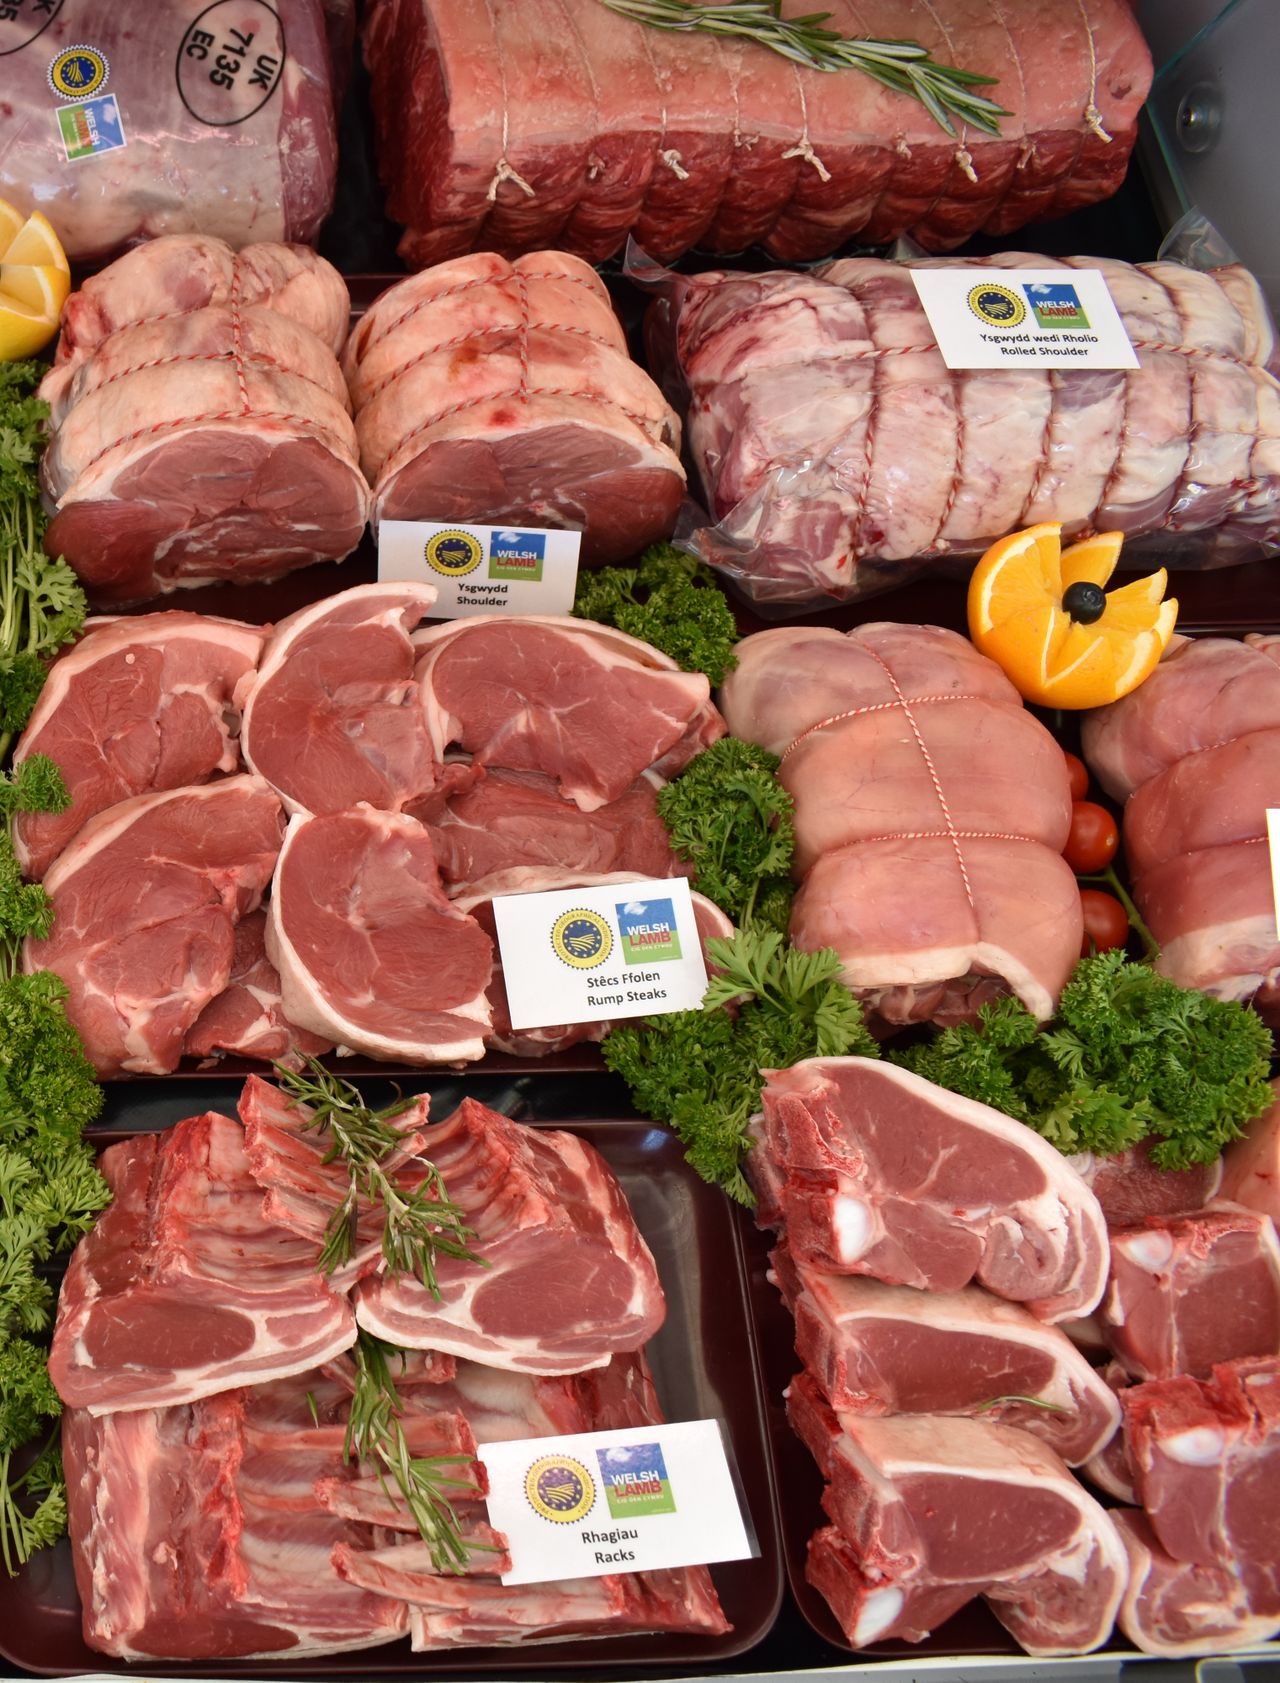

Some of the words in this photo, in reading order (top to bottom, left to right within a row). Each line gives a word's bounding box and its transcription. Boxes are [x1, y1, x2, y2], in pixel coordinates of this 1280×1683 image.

[186, 29, 215, 60] EC
[209, 28, 255, 90] 7135
[248, 54, 278, 91] UK
[84, 108, 101, 146] WELSH
[1036, 301, 1075, 309] WELSH
[1039, 307, 1078, 316] LAMB
[980, 333, 1030, 344] Ysgwydd
[1033, 334, 1060, 342] wedi
[1063, 334, 1098, 343] Rholio
[1001, 347, 1036, 355] Rolled
[1039, 347, 1088, 356] Shoulder
[496, 557, 537, 567] LAMB
[497, 550, 537, 560] WELSH
[458, 583, 508, 594] Ysgwydd
[457, 596, 508, 606] Shoulder
[626, 923, 670, 936] WELSH
[629, 931, 672, 946] LAMB
[587, 975, 619, 988] Stêcs
[622, 971, 660, 984] Ffolen
[587, 994, 624, 1006] Rump
[627, 988, 667, 1002] Steaks
[611, 1471, 660, 1486] WELSH
[614, 1481, 662, 1497] LAMB
[581, 1528, 638, 1544] Rhagiau
[594, 1549, 635, 1564] Racks
